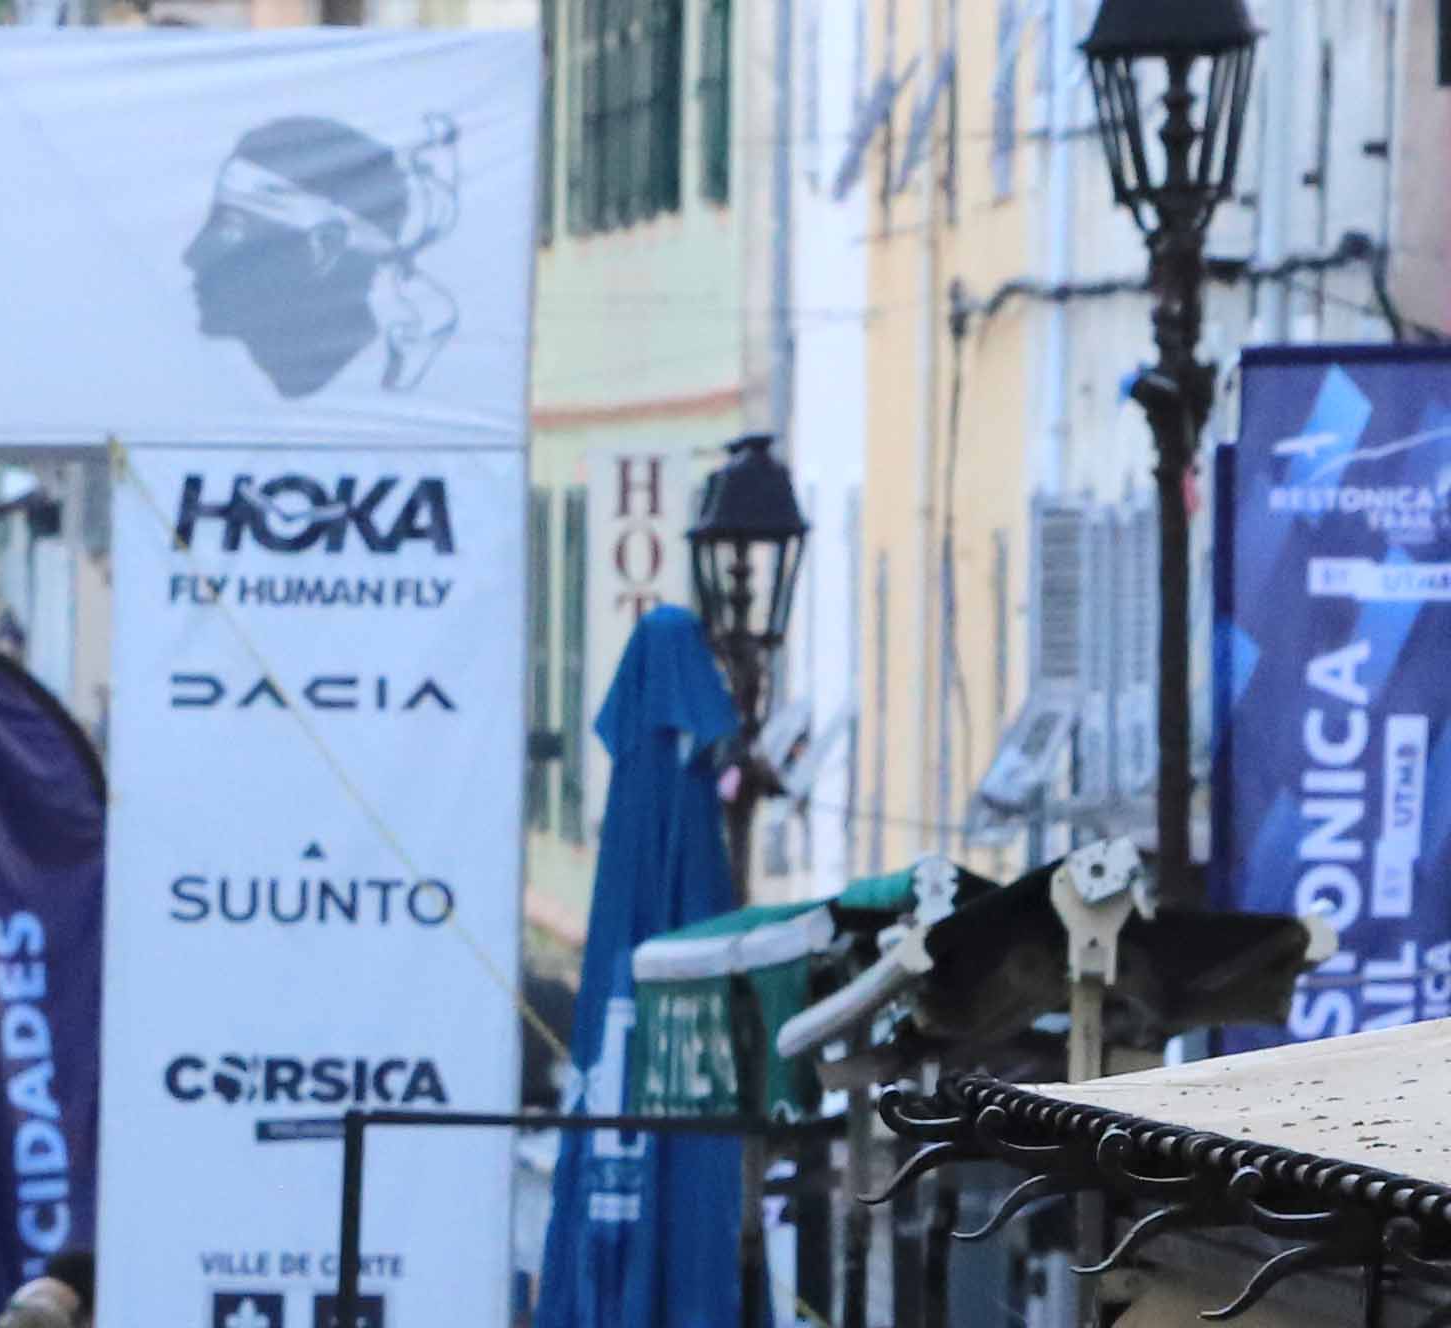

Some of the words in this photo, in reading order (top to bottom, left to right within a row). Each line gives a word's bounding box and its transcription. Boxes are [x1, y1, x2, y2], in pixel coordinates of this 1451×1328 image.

[172, 472, 456, 556] HOKA
[169, 574, 230, 606] FLY
[238, 575, 385, 607] HUMAN
[394, 577, 455, 608] FLY
[170, 673, 458, 712] DACIA
[168, 875, 456, 927] SUUNTO
[163, 1054, 450, 1106] CORSICA
[199, 1251, 270, 1277] VILLE
[278, 1253, 311, 1277] DE
[319, 1253, 407, 1278] CRTE
